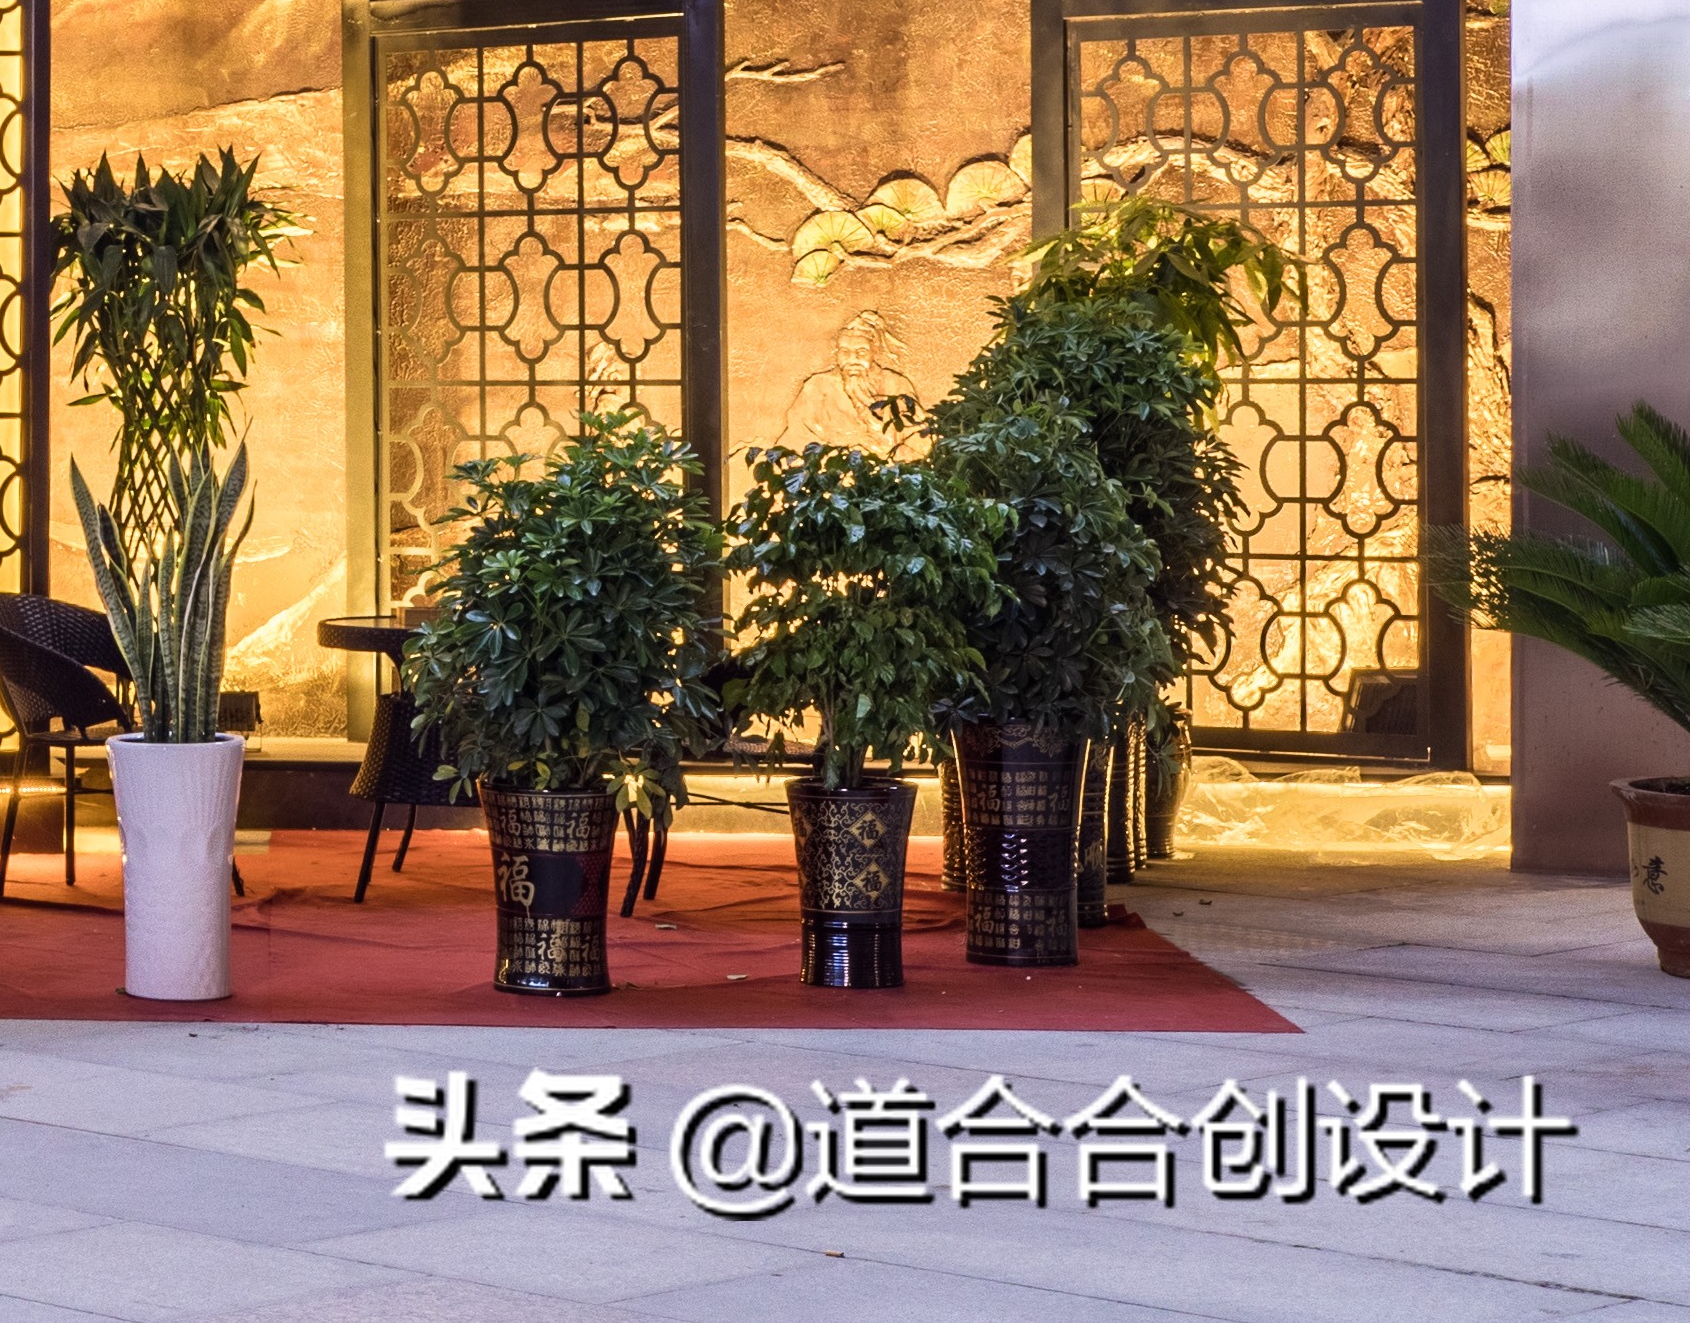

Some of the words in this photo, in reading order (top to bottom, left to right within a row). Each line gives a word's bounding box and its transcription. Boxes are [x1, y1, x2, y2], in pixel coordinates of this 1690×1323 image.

[856, 818, 879, 841] 福
[498, 852, 535, 919] 福
[860, 870, 884, 893] 福
